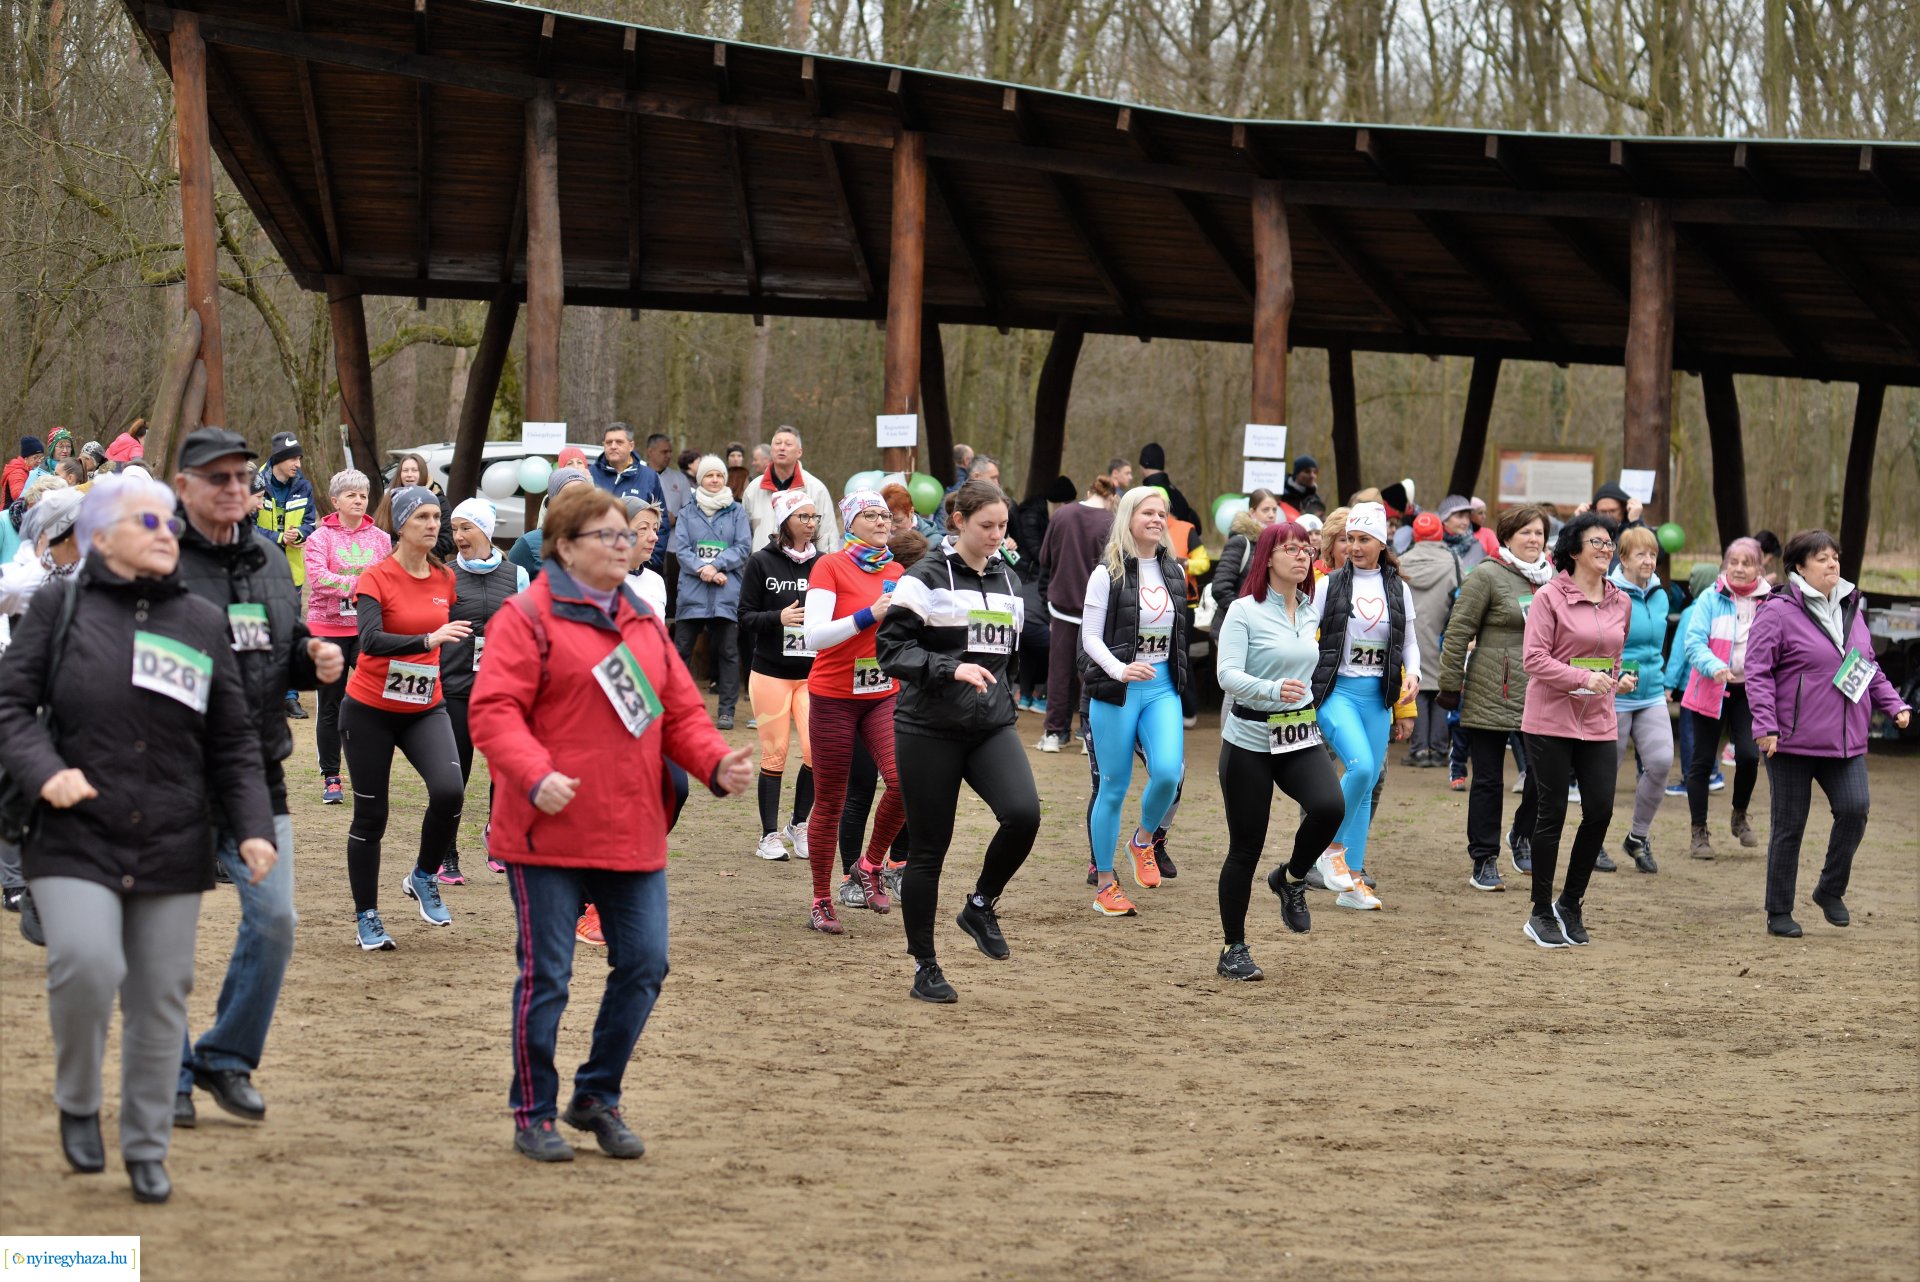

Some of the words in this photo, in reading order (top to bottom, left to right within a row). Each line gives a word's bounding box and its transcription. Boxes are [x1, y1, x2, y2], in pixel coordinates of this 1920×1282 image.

[765, 577, 809, 593] GymB
[972, 622, 1005, 645] 101
[1137, 635, 1167, 652] 214
[1351, 647, 1385, 665] 215
[141, 651, 196, 691] 026
[1842, 662, 1867, 694] 051
[388, 672, 429, 695] 218
[605, 658, 645, 717] 023
[1271, 722, 1309, 745] 100
